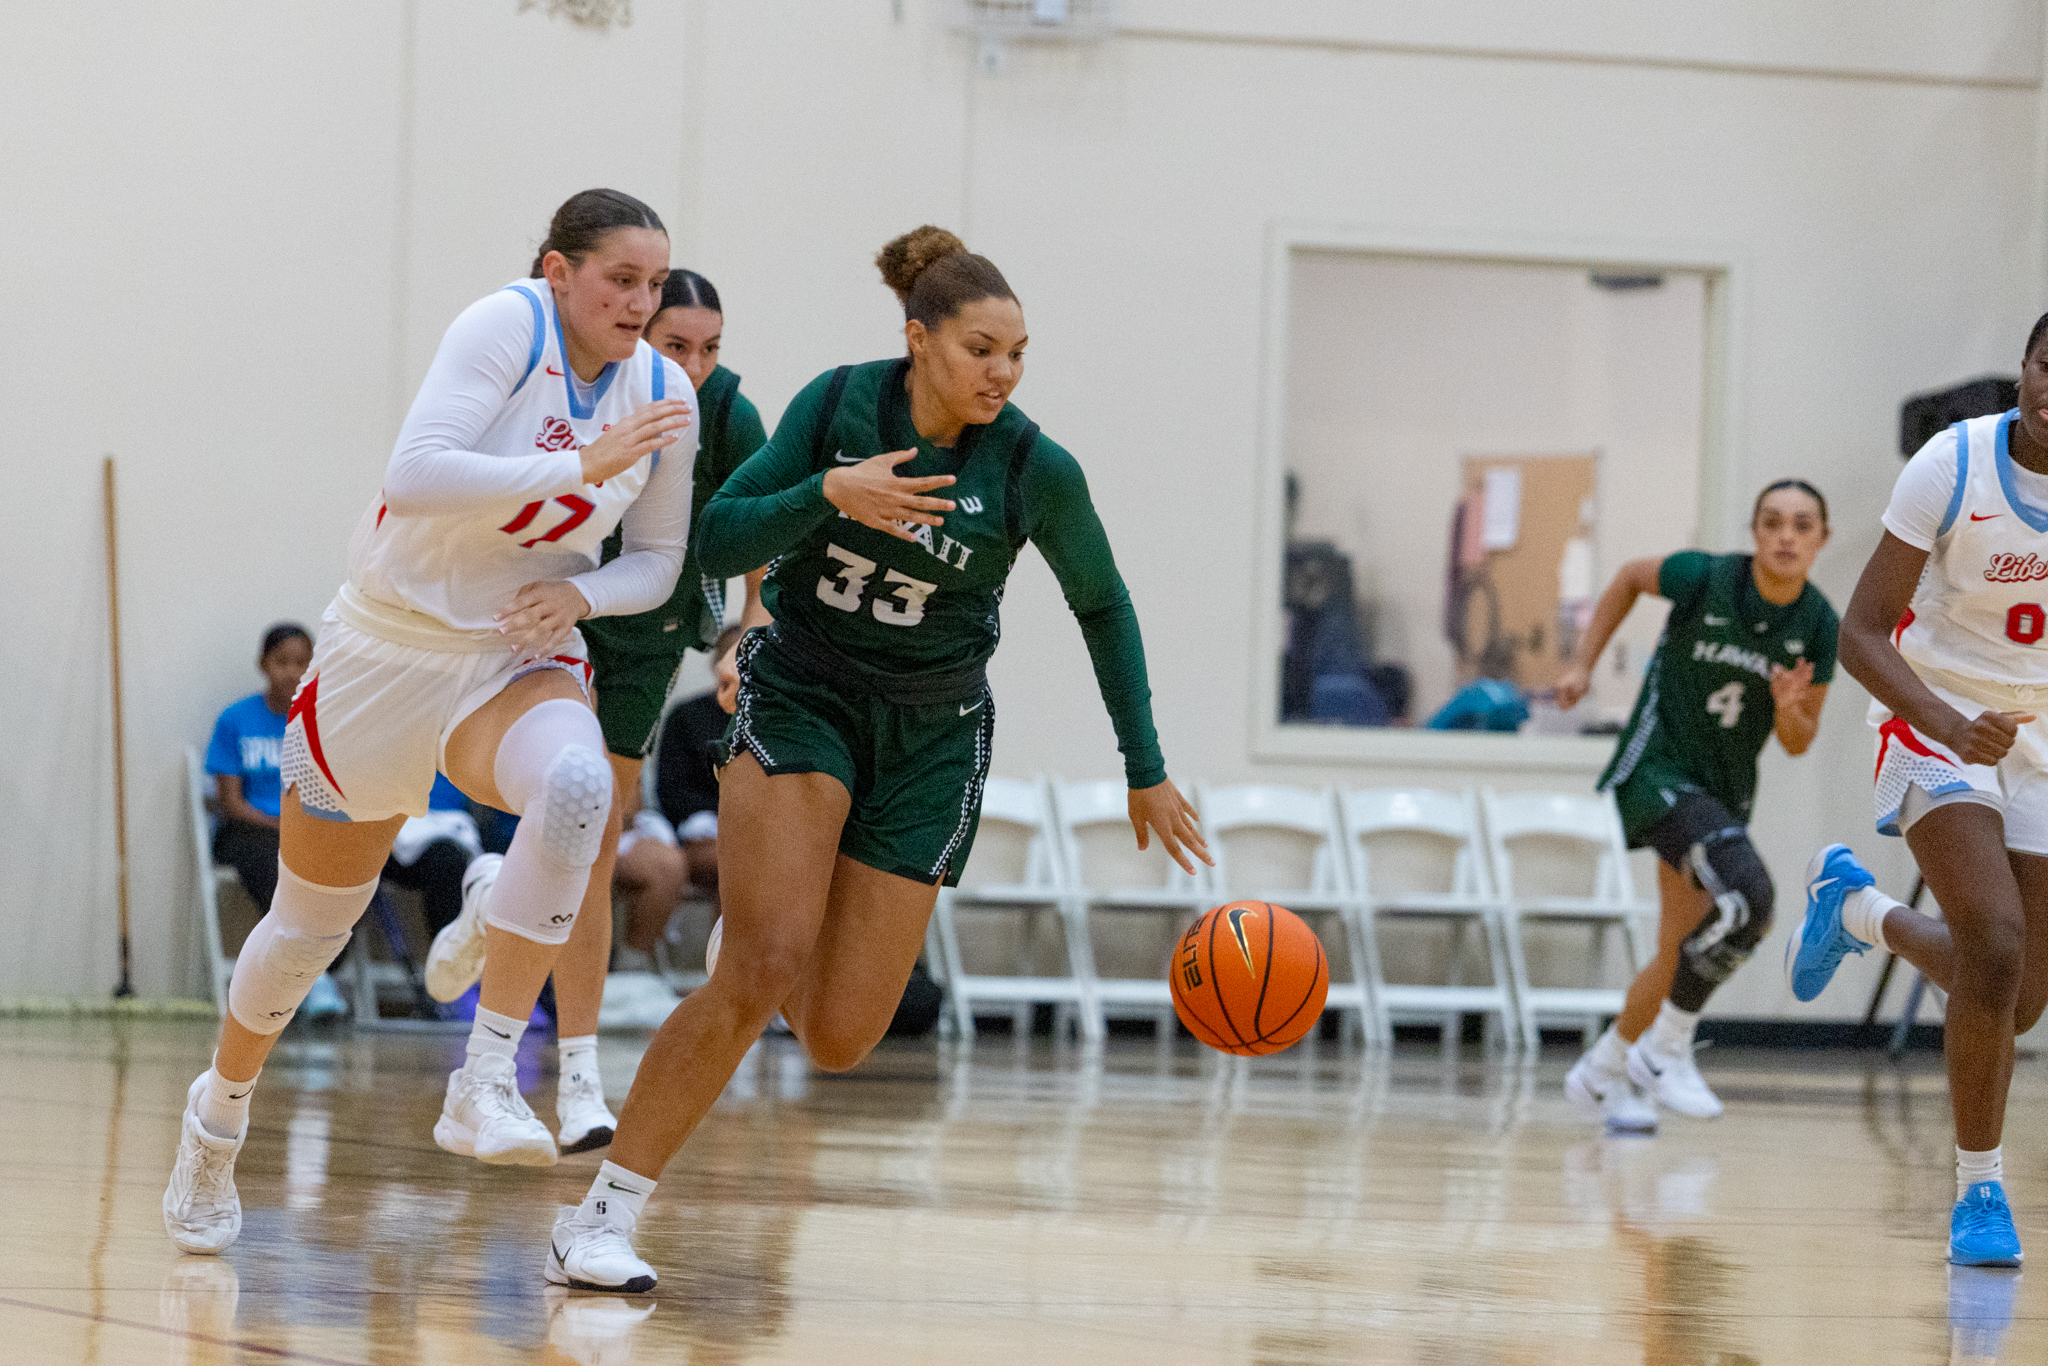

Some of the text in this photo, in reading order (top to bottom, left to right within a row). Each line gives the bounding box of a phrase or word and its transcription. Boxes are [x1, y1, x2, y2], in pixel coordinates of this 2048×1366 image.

[498, 493, 597, 548] 17
[816, 542, 938, 627] 33
[1984, 552, 2048, 583] Libe
[2005, 602, 2046, 646] 0
[1706, 681, 1744, 728] 4
[1182, 914, 1208, 992] ELITE
